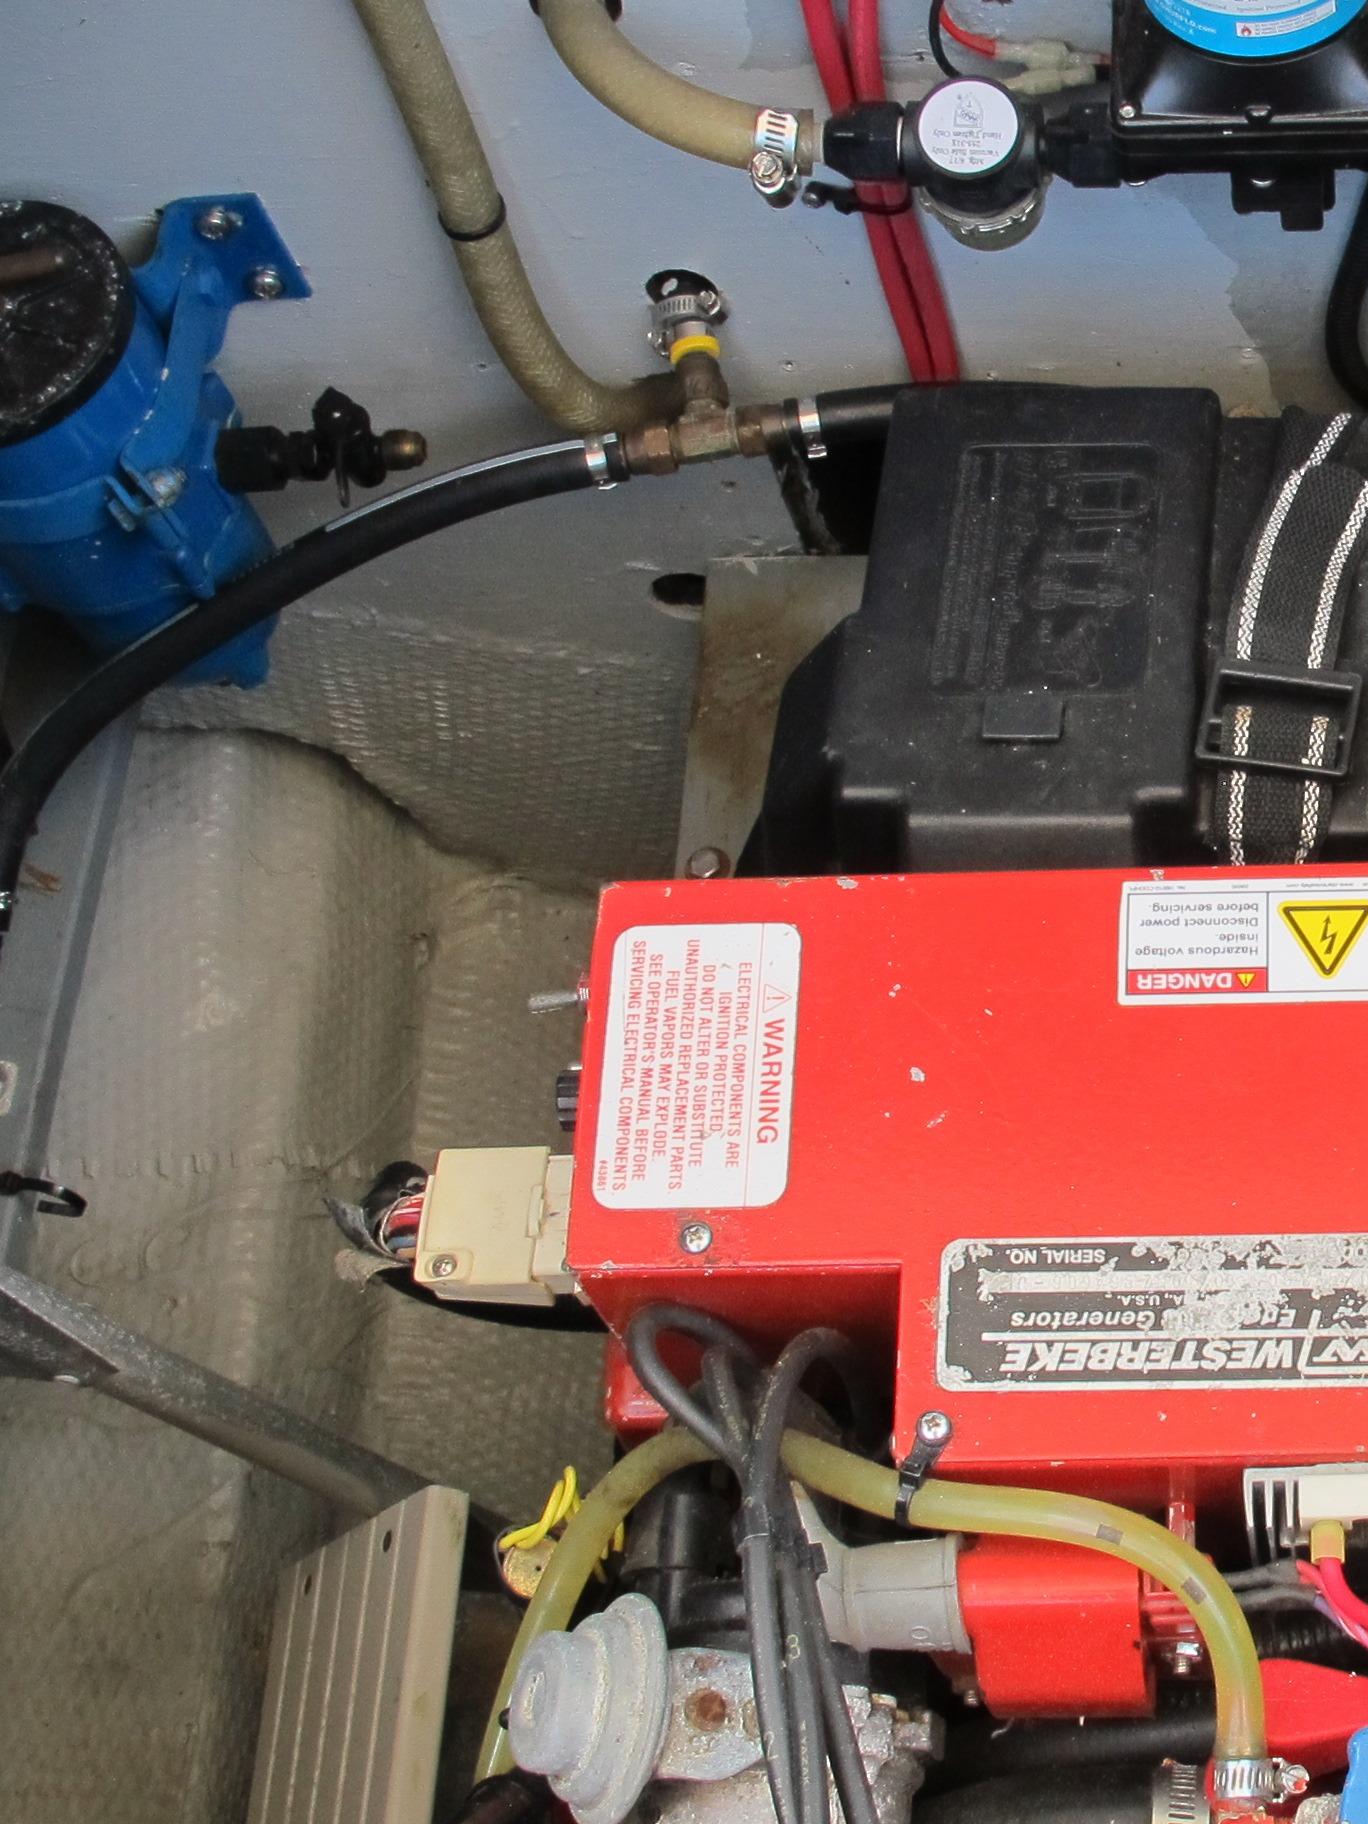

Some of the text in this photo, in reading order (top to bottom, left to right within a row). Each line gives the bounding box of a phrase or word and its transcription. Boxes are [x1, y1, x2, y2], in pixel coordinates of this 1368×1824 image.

[1140, 916, 1259, 928] Disconnect power
[1148, 902, 1259, 914] before servicing.
[1135, 944, 1259, 958] Hazardous voltage
[1215, 932, 1259, 943] inside.
[627, 940, 646, 1009] SERVICING
[1136, 972, 1232, 990] DANGER
[716, 992, 732, 1050] IGNITION
[620, 1014, 641, 1092] ELECTRICAL
[632, 954, 663, 1181] SEE OPERATOR'S MANUAL BEFORE
[652, 970, 680, 1162] FUEL VAPORS MAY EXPLODE.
[668, 939, 700, 1193] UNAUTHORIZED REPLACEMENT PARTS.
[688, 965, 717, 1167] DO NOT ALTER OR SUBSTITUTE
[725, 962, 753, 1168] ELECTRICAL COMPONENTS ARE
[756, 1018, 785, 1144] WARNING
[1004, 1248, 1107, 1264] SERIAL NO.
[1010, 1309, 1155, 1329] Generators
[999, 1338, 1294, 1372] WESTERBEKE
